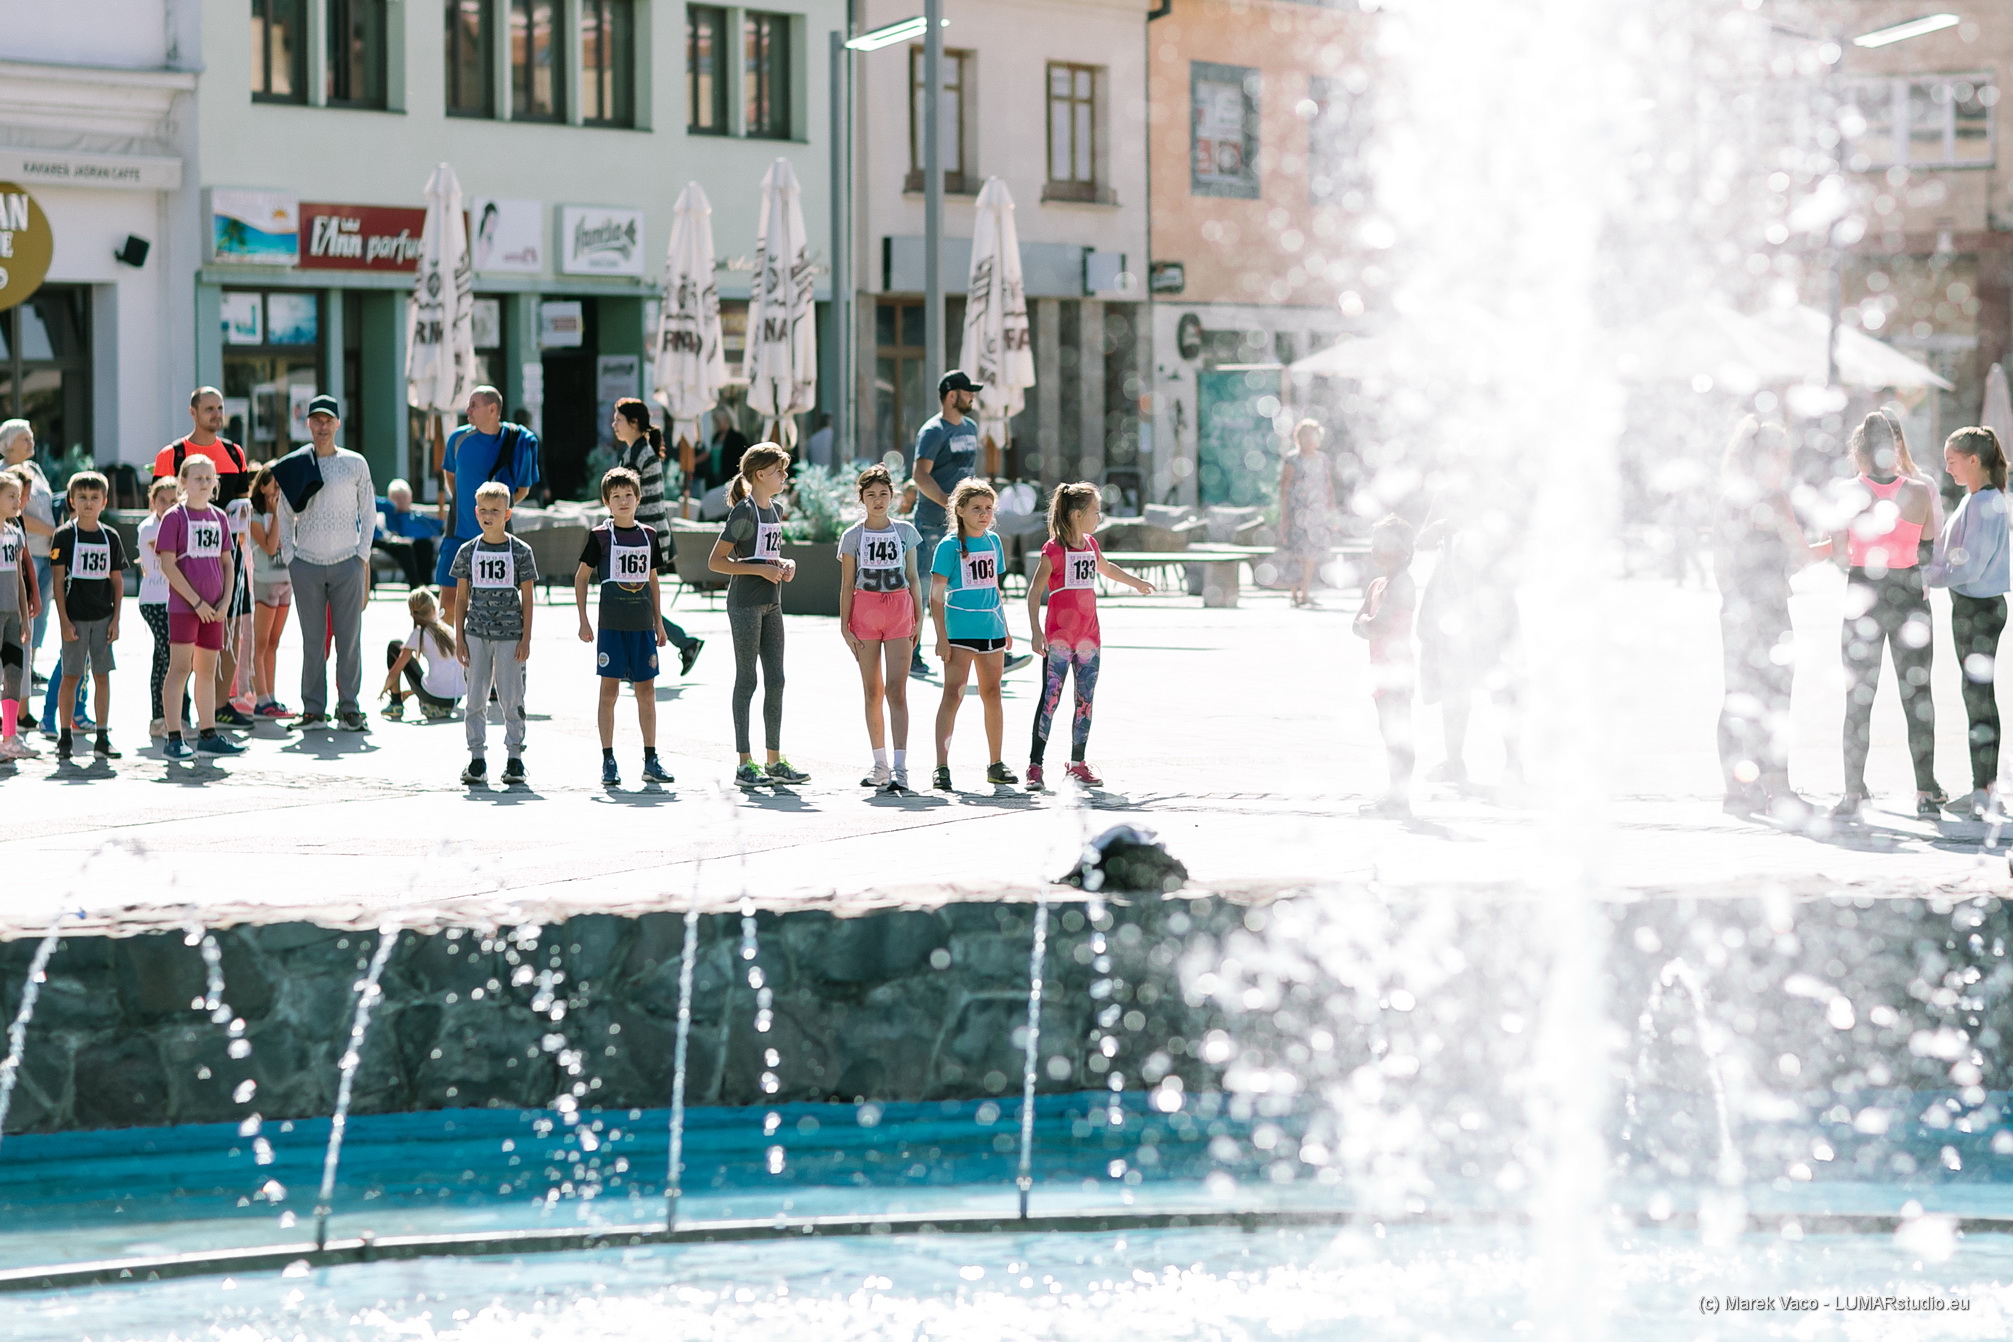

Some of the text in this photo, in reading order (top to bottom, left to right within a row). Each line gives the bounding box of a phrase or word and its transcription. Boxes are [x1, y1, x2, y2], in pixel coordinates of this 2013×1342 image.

[365, 228, 422, 265] parfu
[195, 528, 220, 548] 134
[80, 551, 107, 572] 135
[867, 541, 898, 561] 143
[478, 559, 506, 580] 113
[618, 553, 647, 574] 163
[968, 558, 995, 581] 103
[1073, 559, 1096, 580] 133
